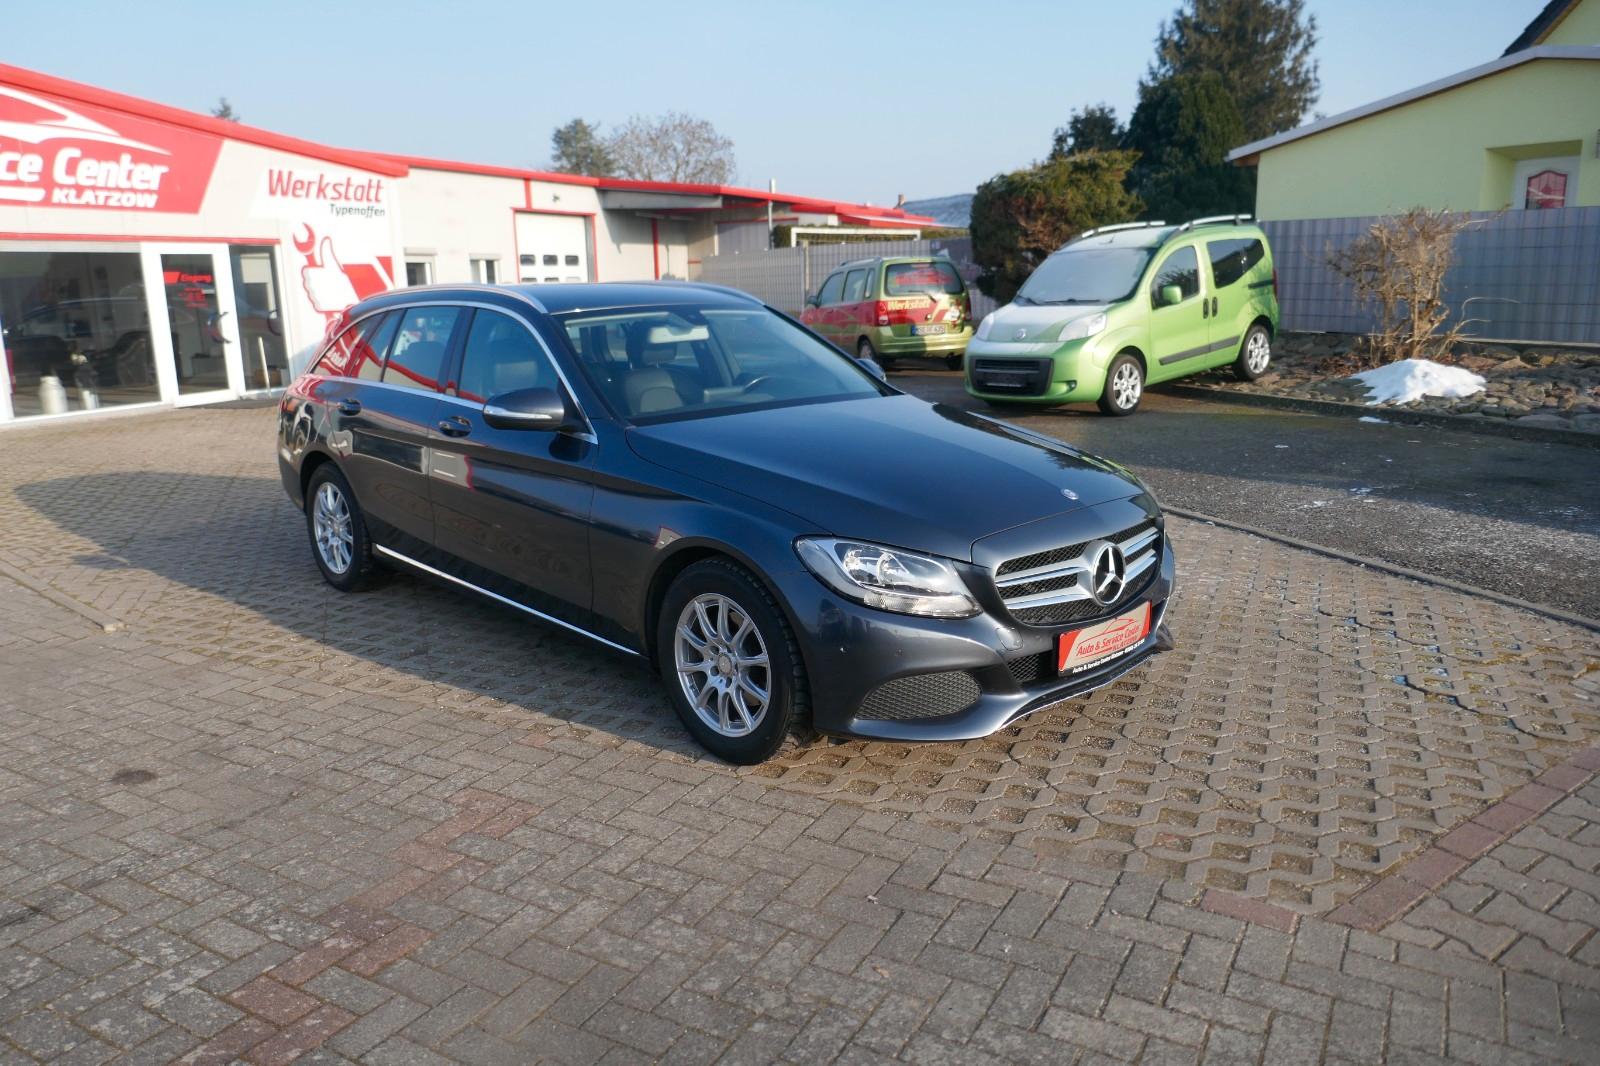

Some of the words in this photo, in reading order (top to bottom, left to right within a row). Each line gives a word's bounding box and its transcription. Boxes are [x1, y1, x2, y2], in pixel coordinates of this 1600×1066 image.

[0, 150, 43, 183] ce
[52, 147, 170, 191] Center
[268, 168, 384, 203] Werkstatt
[51, 187, 158, 209] KLATZOW
[329, 203, 386, 218] Typenoffen
[1076, 643, 1094, 656] Auto
